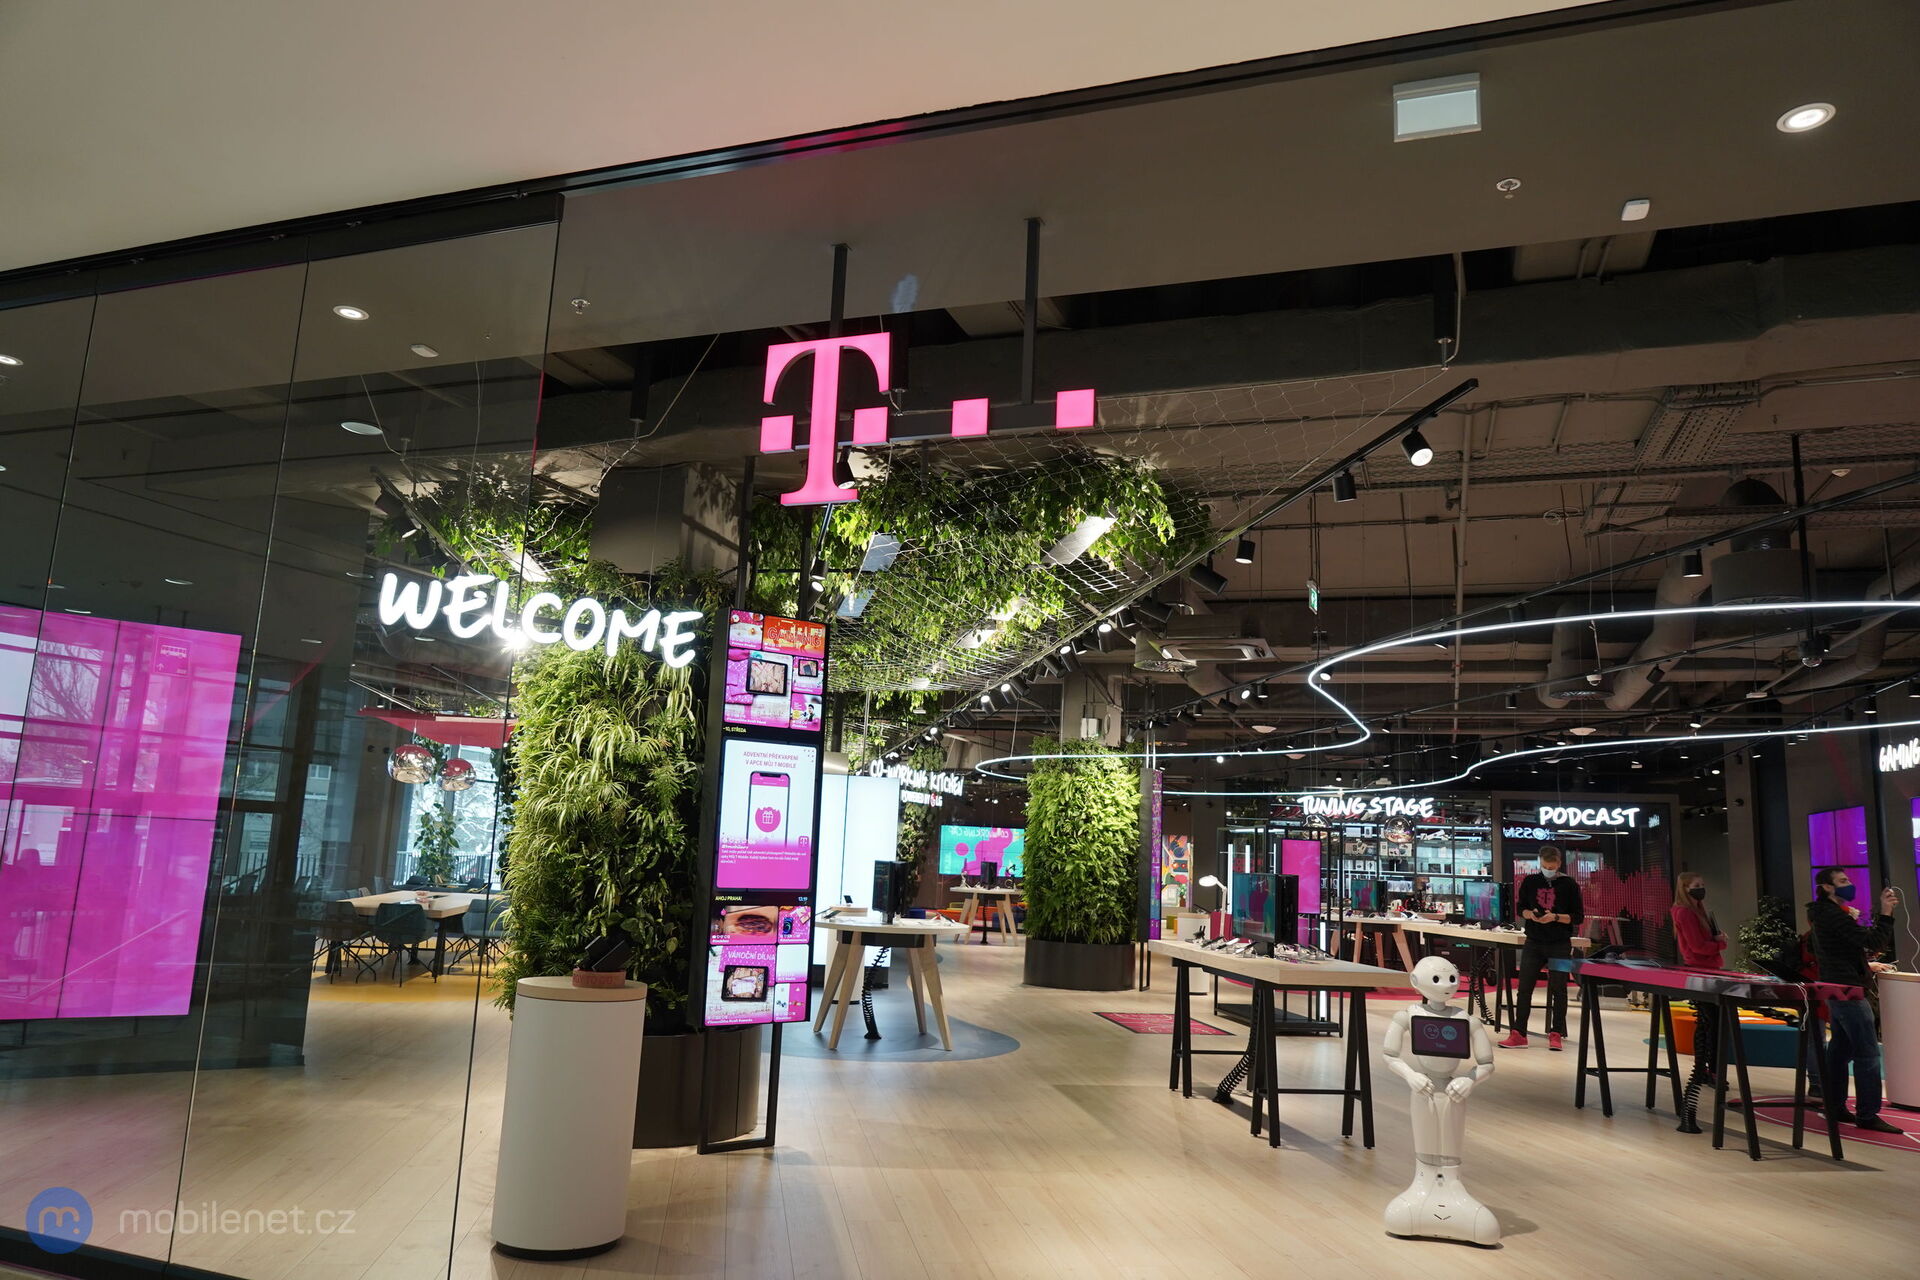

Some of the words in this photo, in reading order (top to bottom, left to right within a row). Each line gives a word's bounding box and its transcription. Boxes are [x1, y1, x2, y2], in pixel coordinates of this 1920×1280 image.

[761, 332, 891, 506] T
[379, 572, 703, 669] WELCOME
[1297, 795, 1367, 816] TUNING
[1367, 796, 1434, 818] STAGE
[1539, 806, 1640, 828] PODCAST
